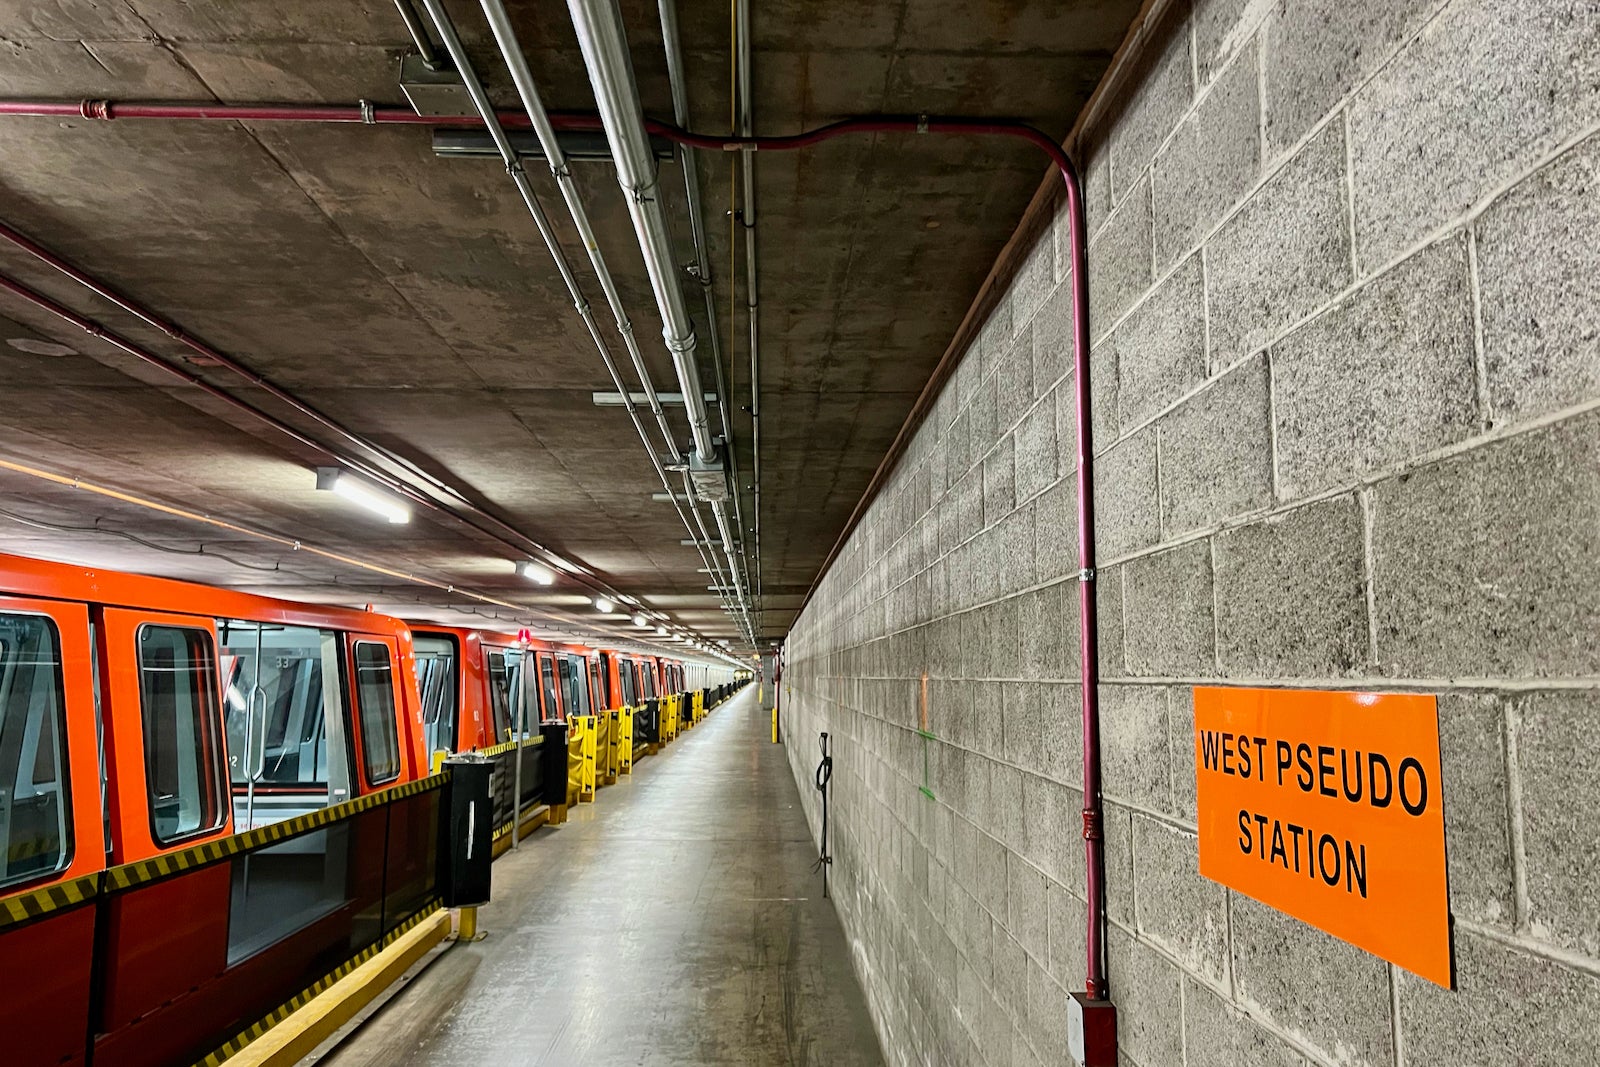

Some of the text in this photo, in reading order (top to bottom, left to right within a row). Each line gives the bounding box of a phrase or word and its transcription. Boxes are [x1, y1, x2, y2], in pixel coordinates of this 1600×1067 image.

[229, 755, 238, 767] 2
[1200, 729, 1428, 817] WEST PSEUDO
[1238, 809, 1367, 899] STATION
